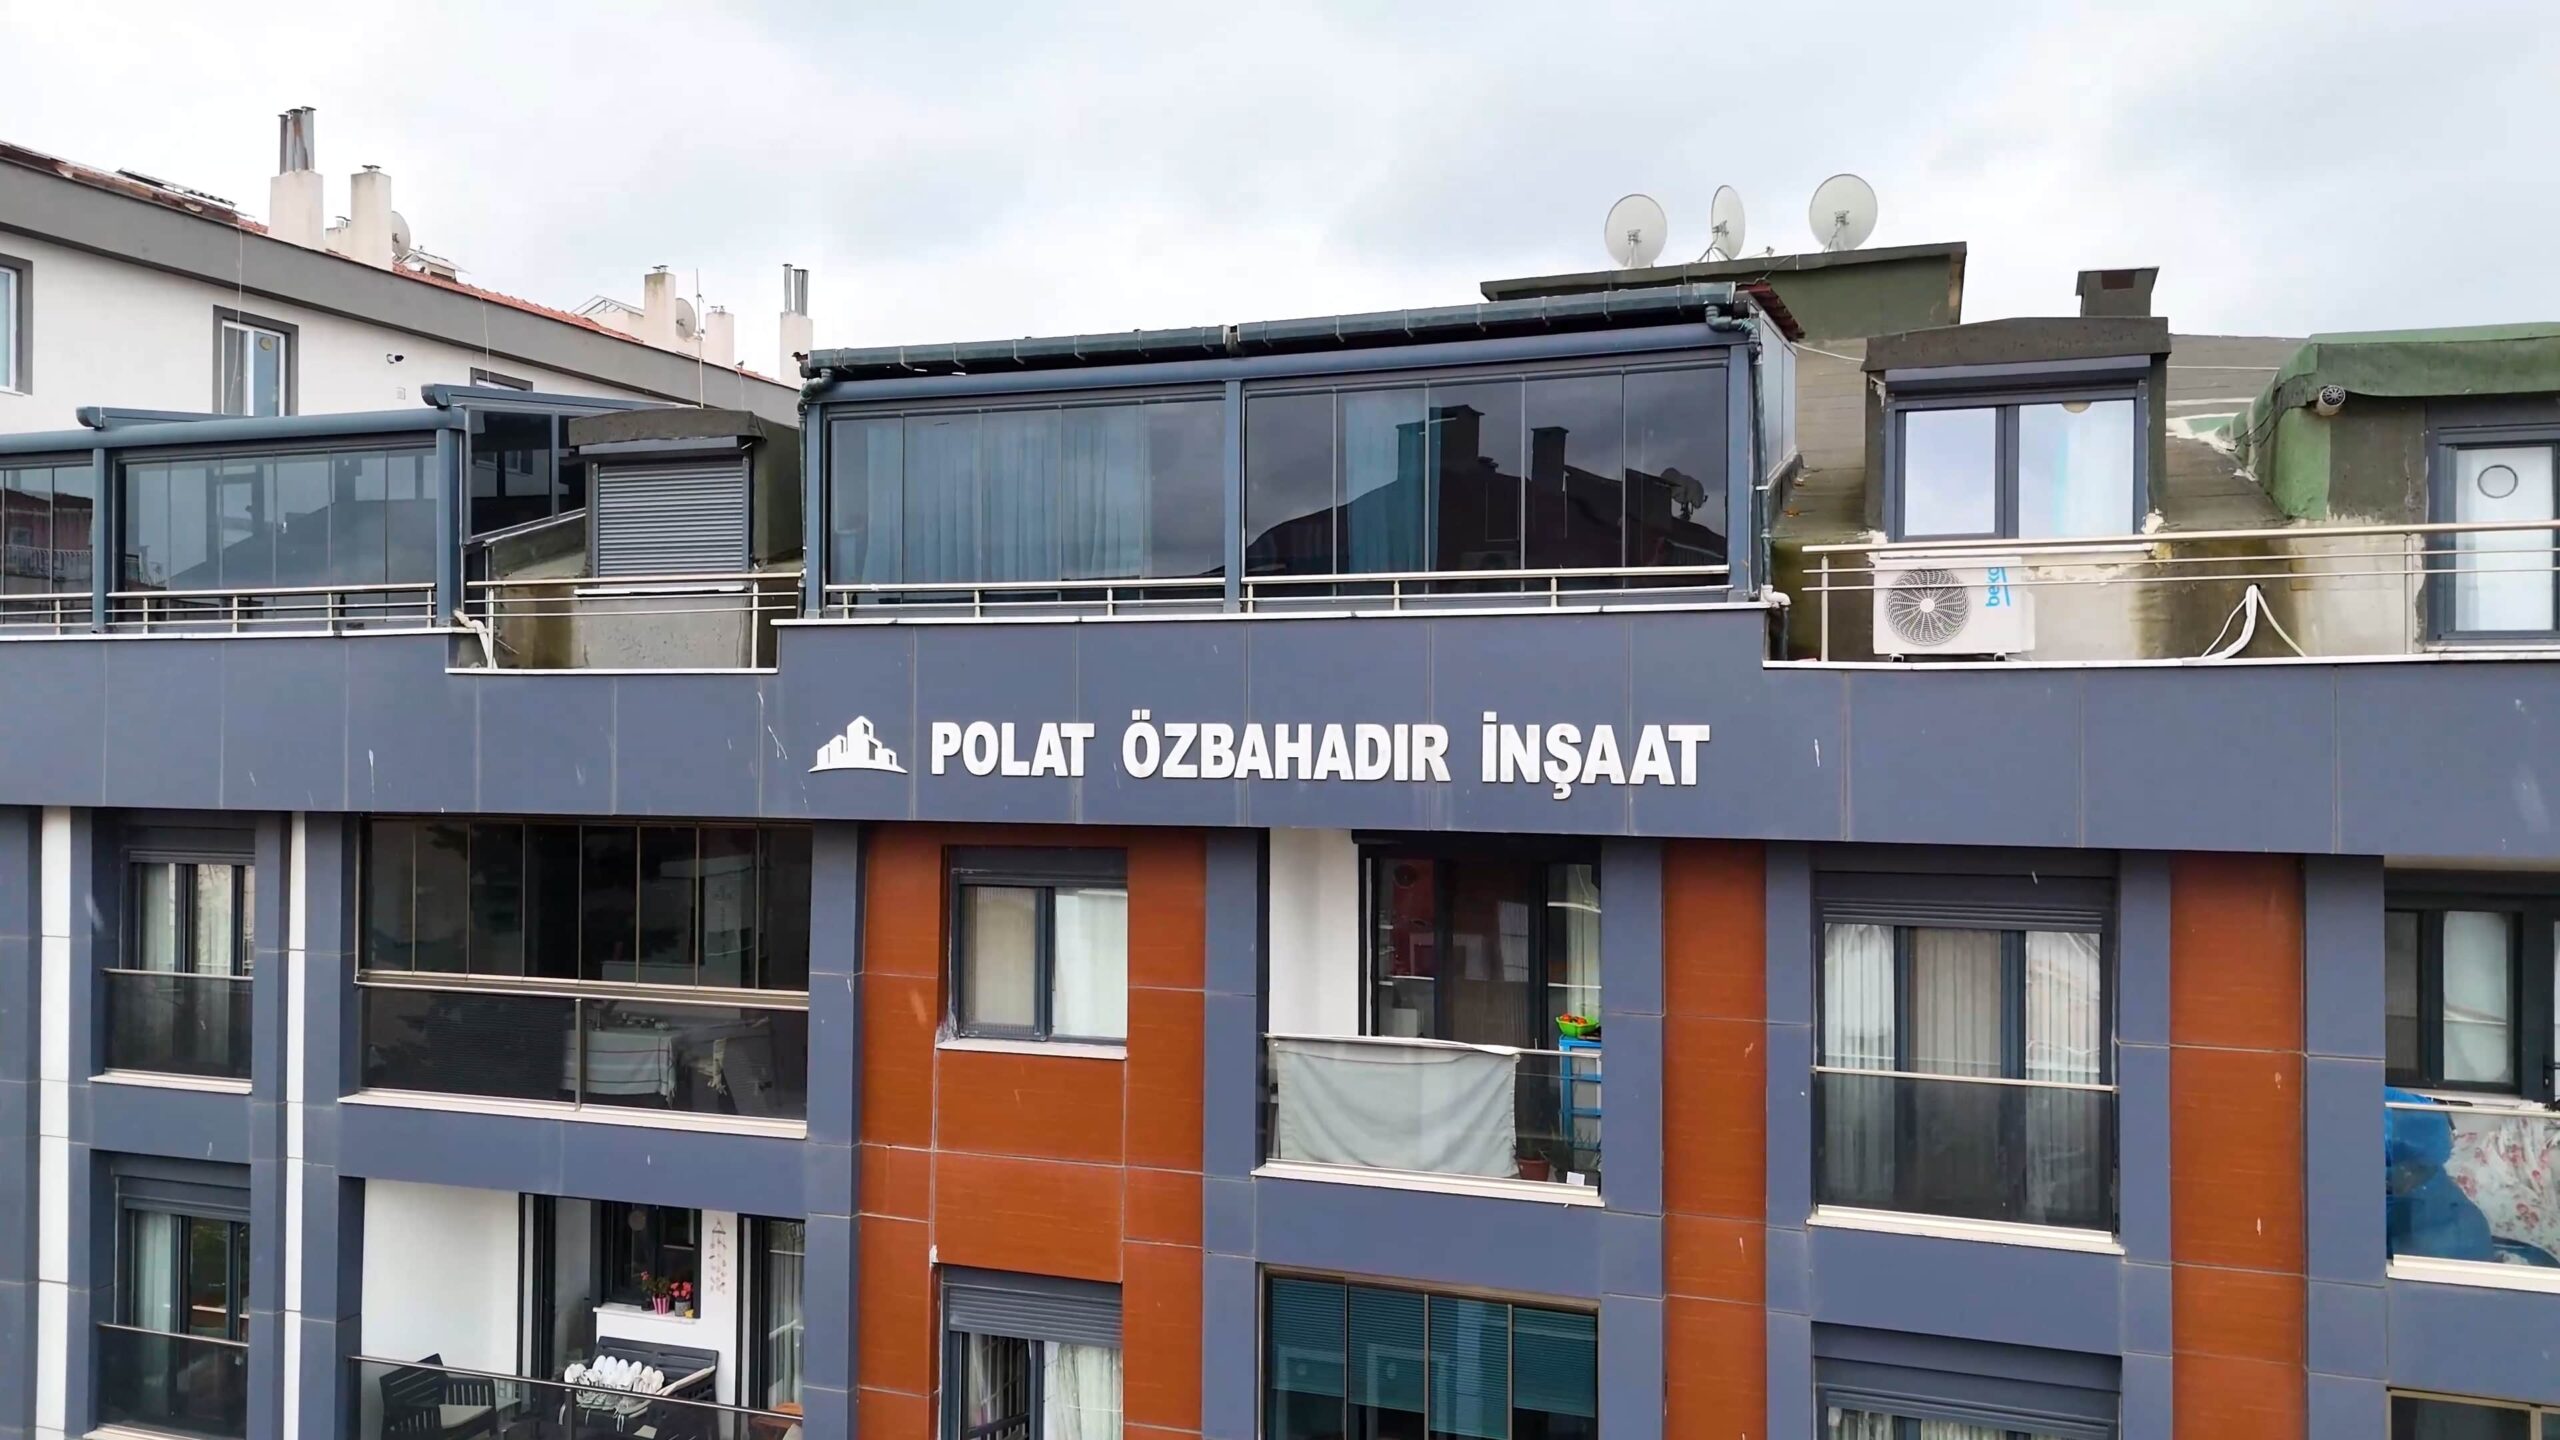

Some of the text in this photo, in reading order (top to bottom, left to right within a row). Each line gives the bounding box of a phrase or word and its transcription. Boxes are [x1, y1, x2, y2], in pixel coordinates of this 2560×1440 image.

[931, 709, 1711, 799] POLAT ÖZBAHADIR İNŞAAT
